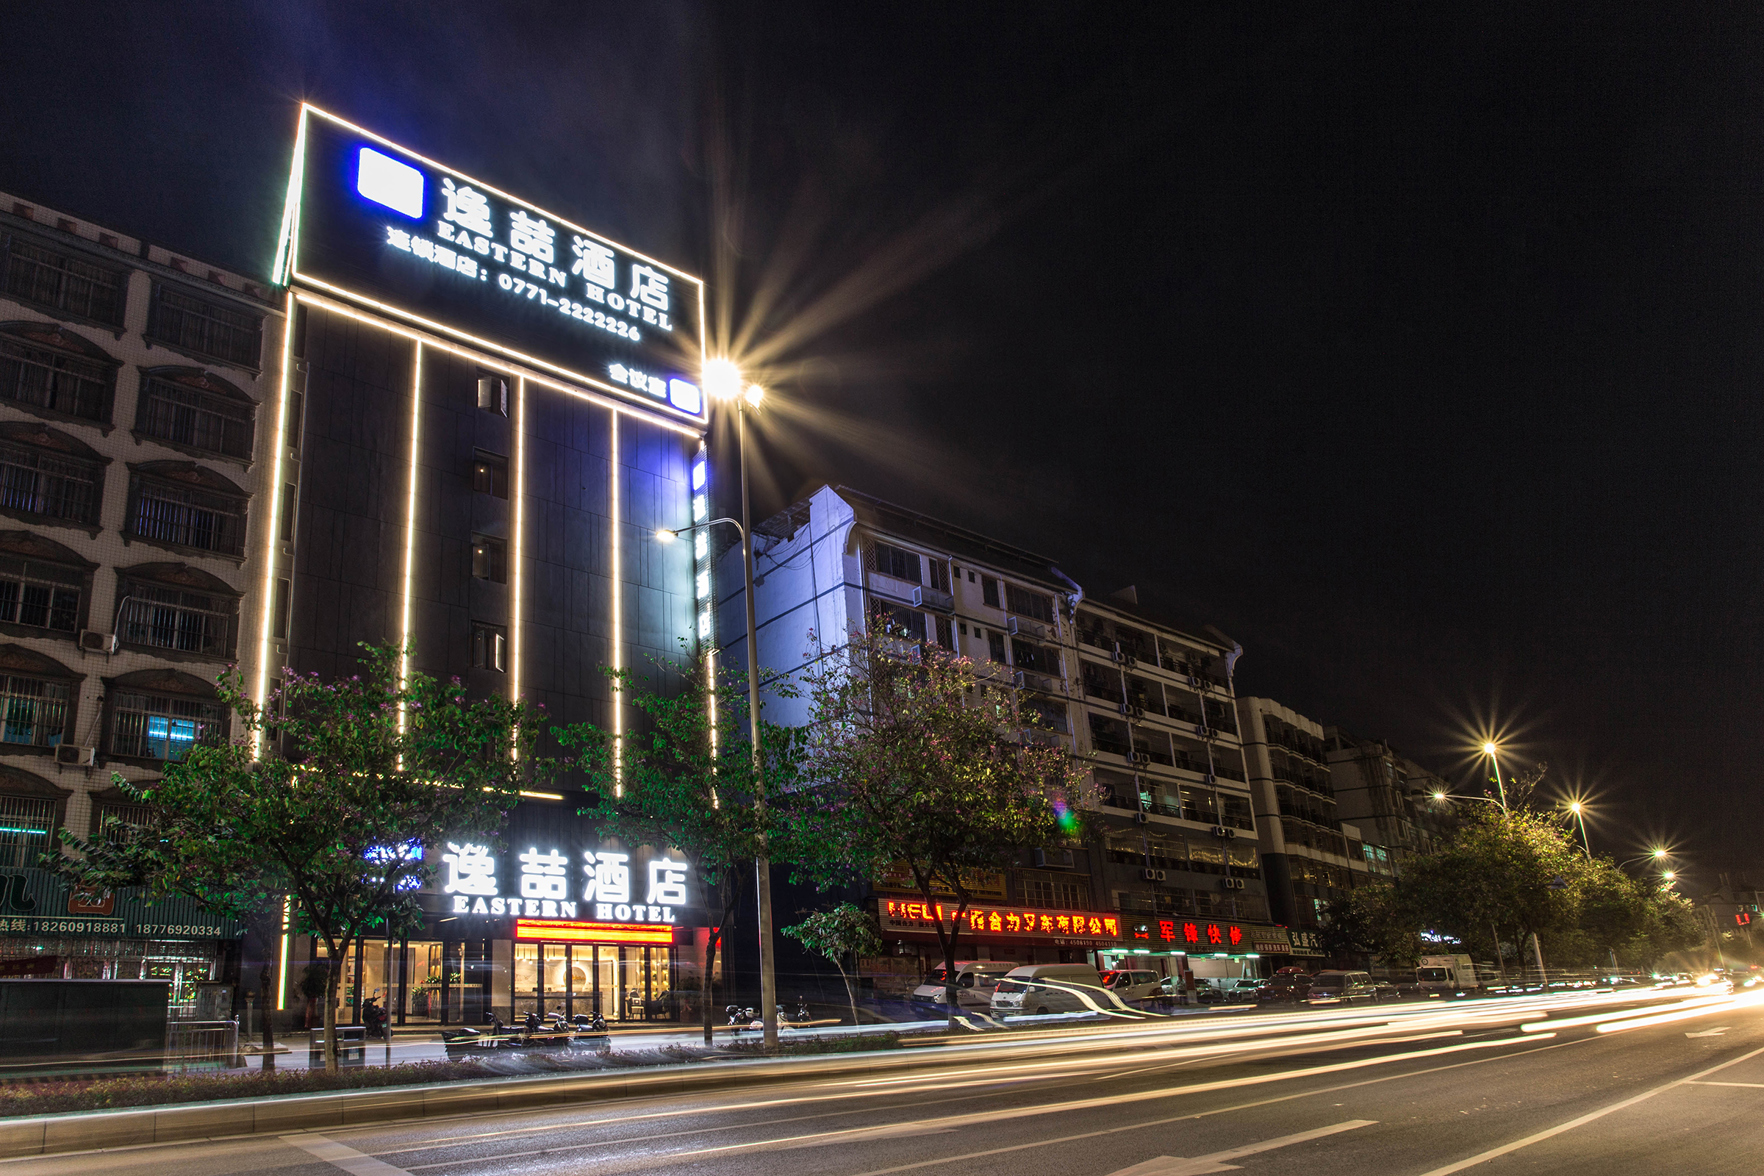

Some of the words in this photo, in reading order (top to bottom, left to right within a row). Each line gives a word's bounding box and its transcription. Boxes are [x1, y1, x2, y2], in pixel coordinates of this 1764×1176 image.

[441, 178, 669, 311] 逸喆酒店
[437, 220, 567, 288] EASTERN
[586, 283, 672, 331] HOTEL
[499, 273, 640, 341] 0771-2222226
[443, 841, 688, 905] 逸喆酒店
[136, 923, 222, 936] 18776920334
[453, 895, 577, 918] EASTERN
[596, 903, 676, 923] HOTEL
[887, 901, 943, 921] HELI
[1159, 920, 1243, 945] 军锋快修
